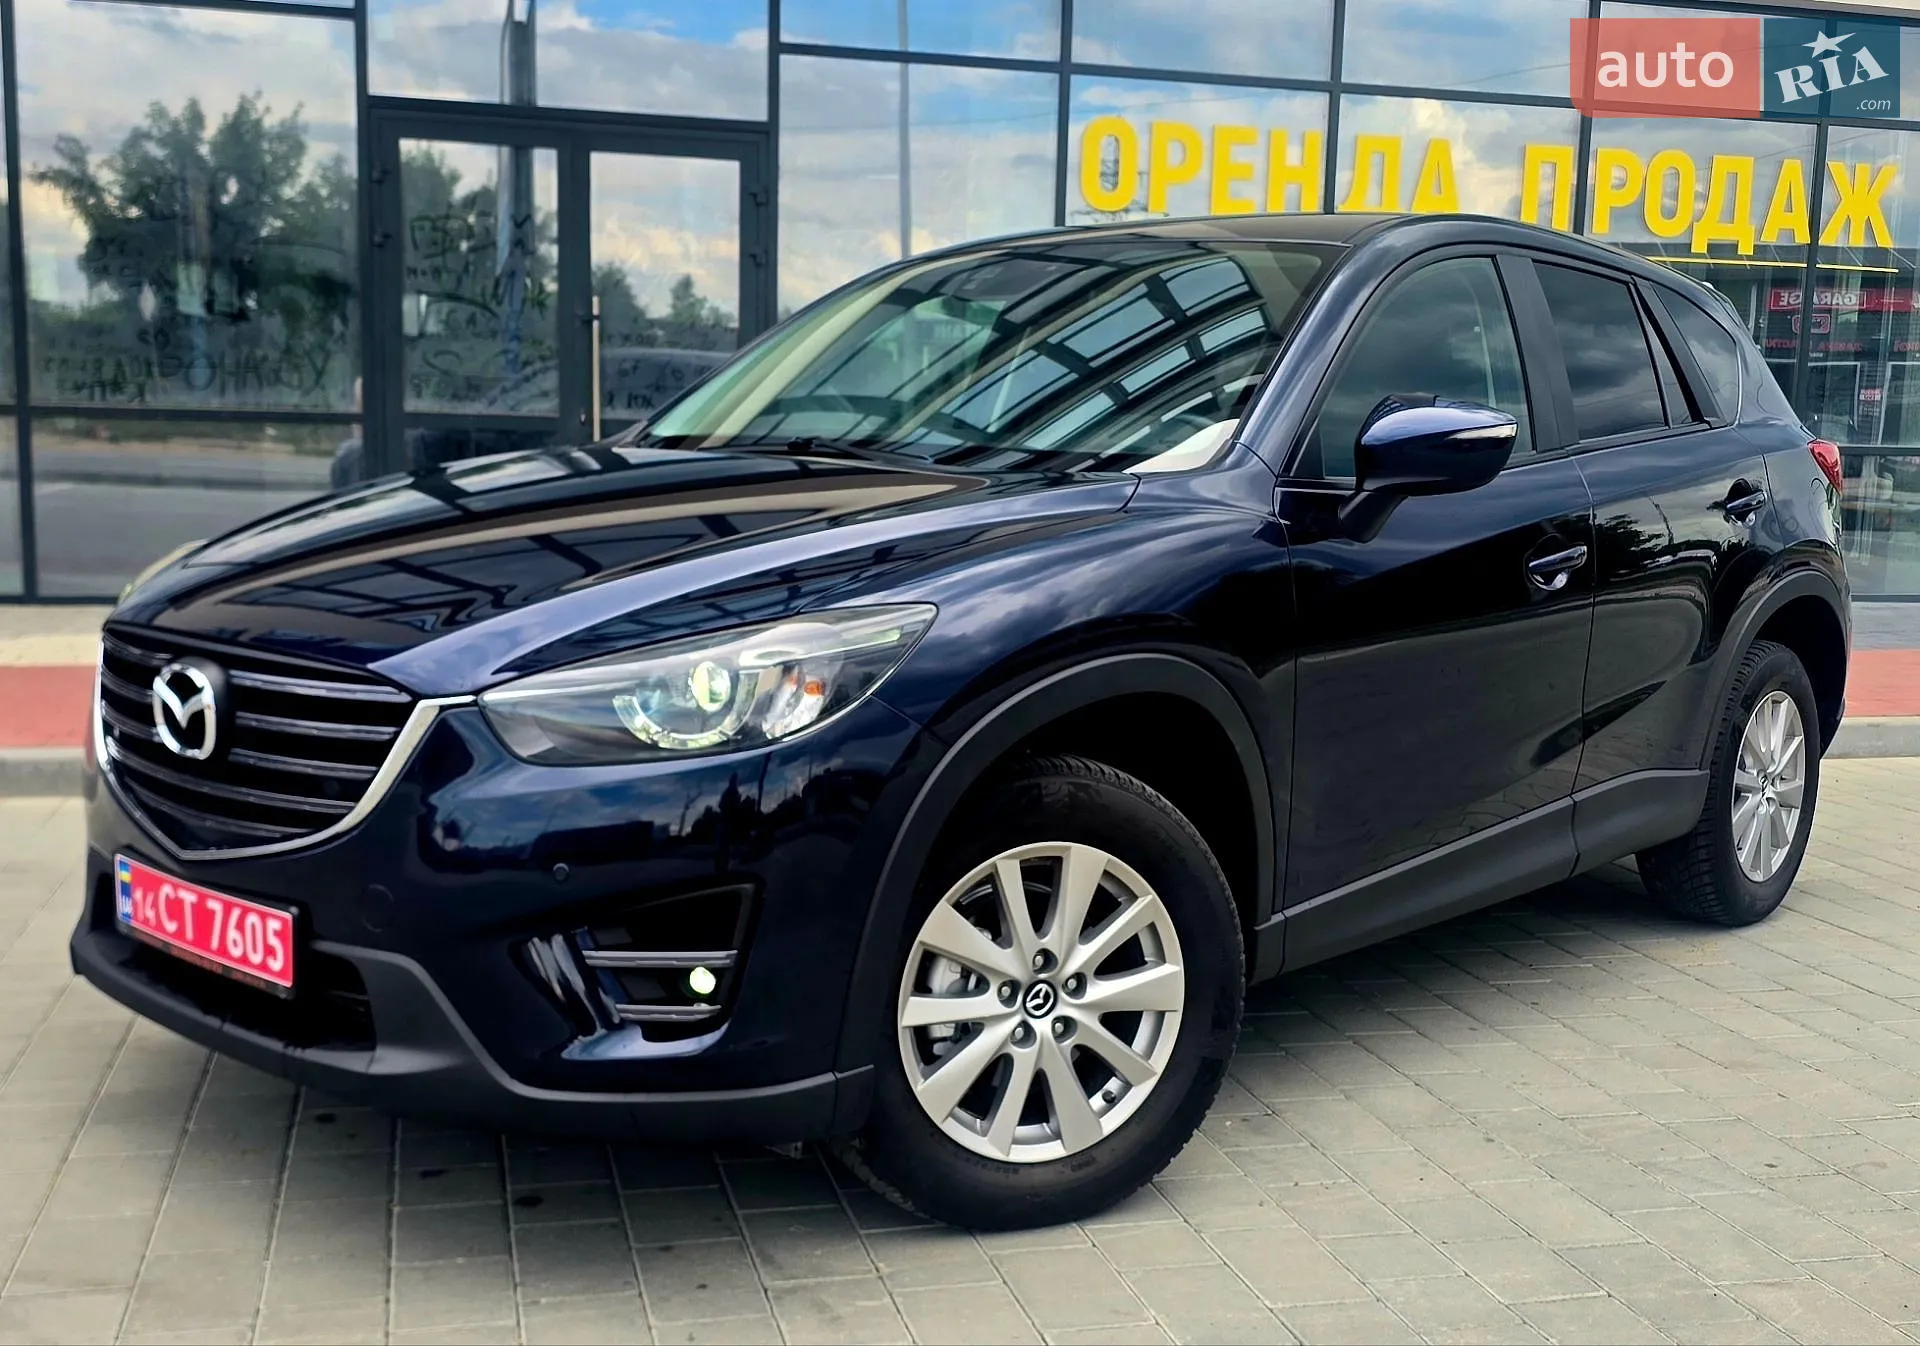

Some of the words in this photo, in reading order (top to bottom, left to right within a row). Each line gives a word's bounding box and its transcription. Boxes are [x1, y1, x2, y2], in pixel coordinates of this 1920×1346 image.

[1080, 115, 1460, 215] ОРЕНДА
[1520, 143, 1900, 256] ПРОДАЖ
[205, 897, 285, 973] 7605
